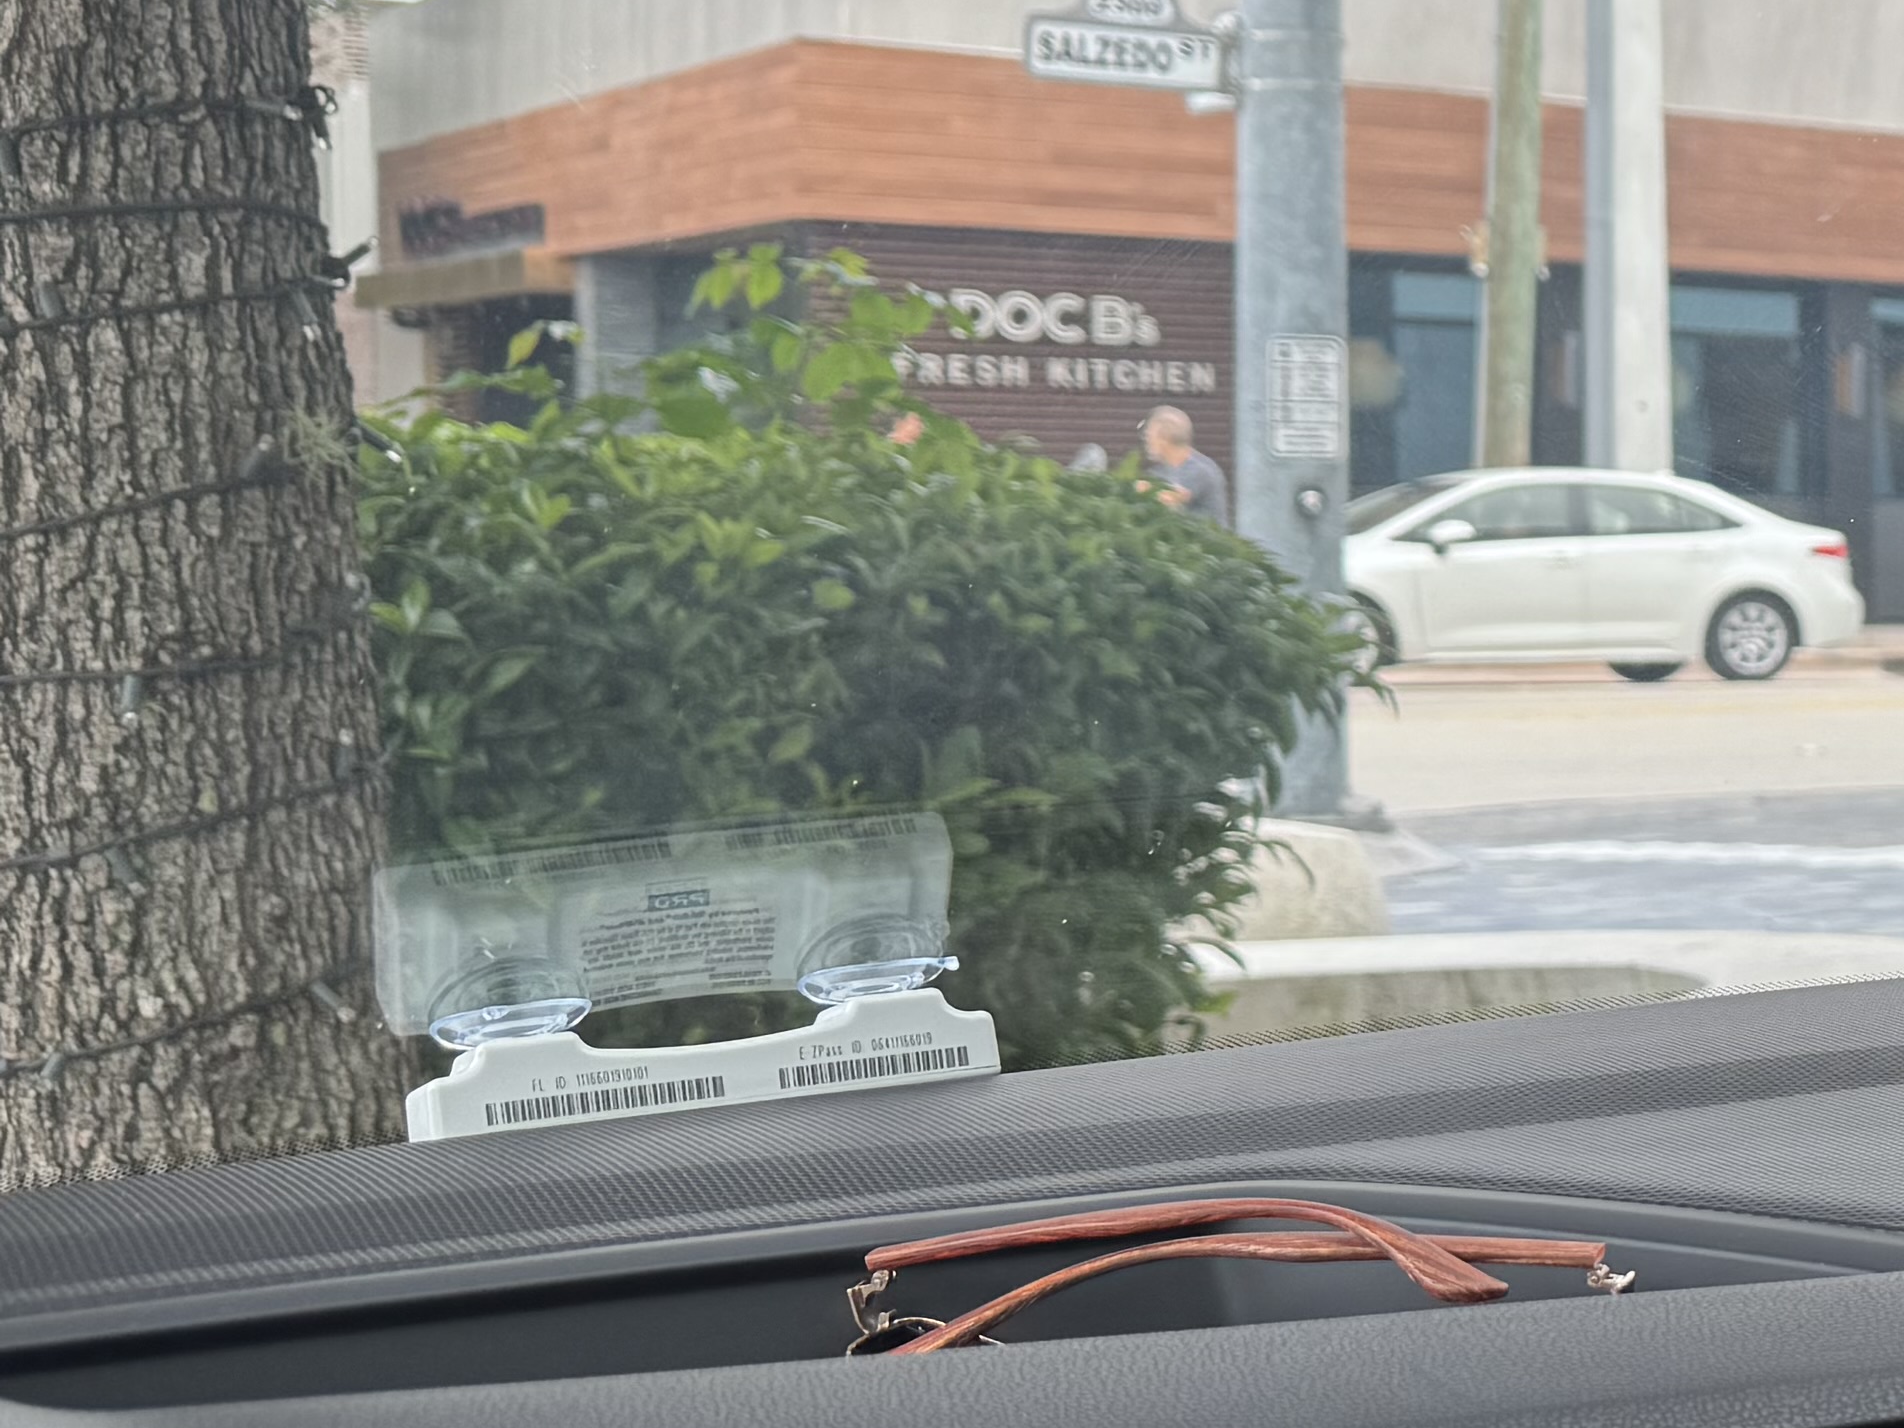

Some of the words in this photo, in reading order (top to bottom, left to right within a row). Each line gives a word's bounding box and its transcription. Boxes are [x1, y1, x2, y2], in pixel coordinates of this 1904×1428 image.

[1037, 29, 1172, 75] SALZEDO
[1176, 35, 1215, 60] ST
[948, 288, 1087, 344] DOC
[890, 350, 1029, 389] FRESH
[1045, 354, 1217, 393] KITCHEN
[531, 1077, 545, 1093] FL
[555, 1075, 566, 1090] ID
